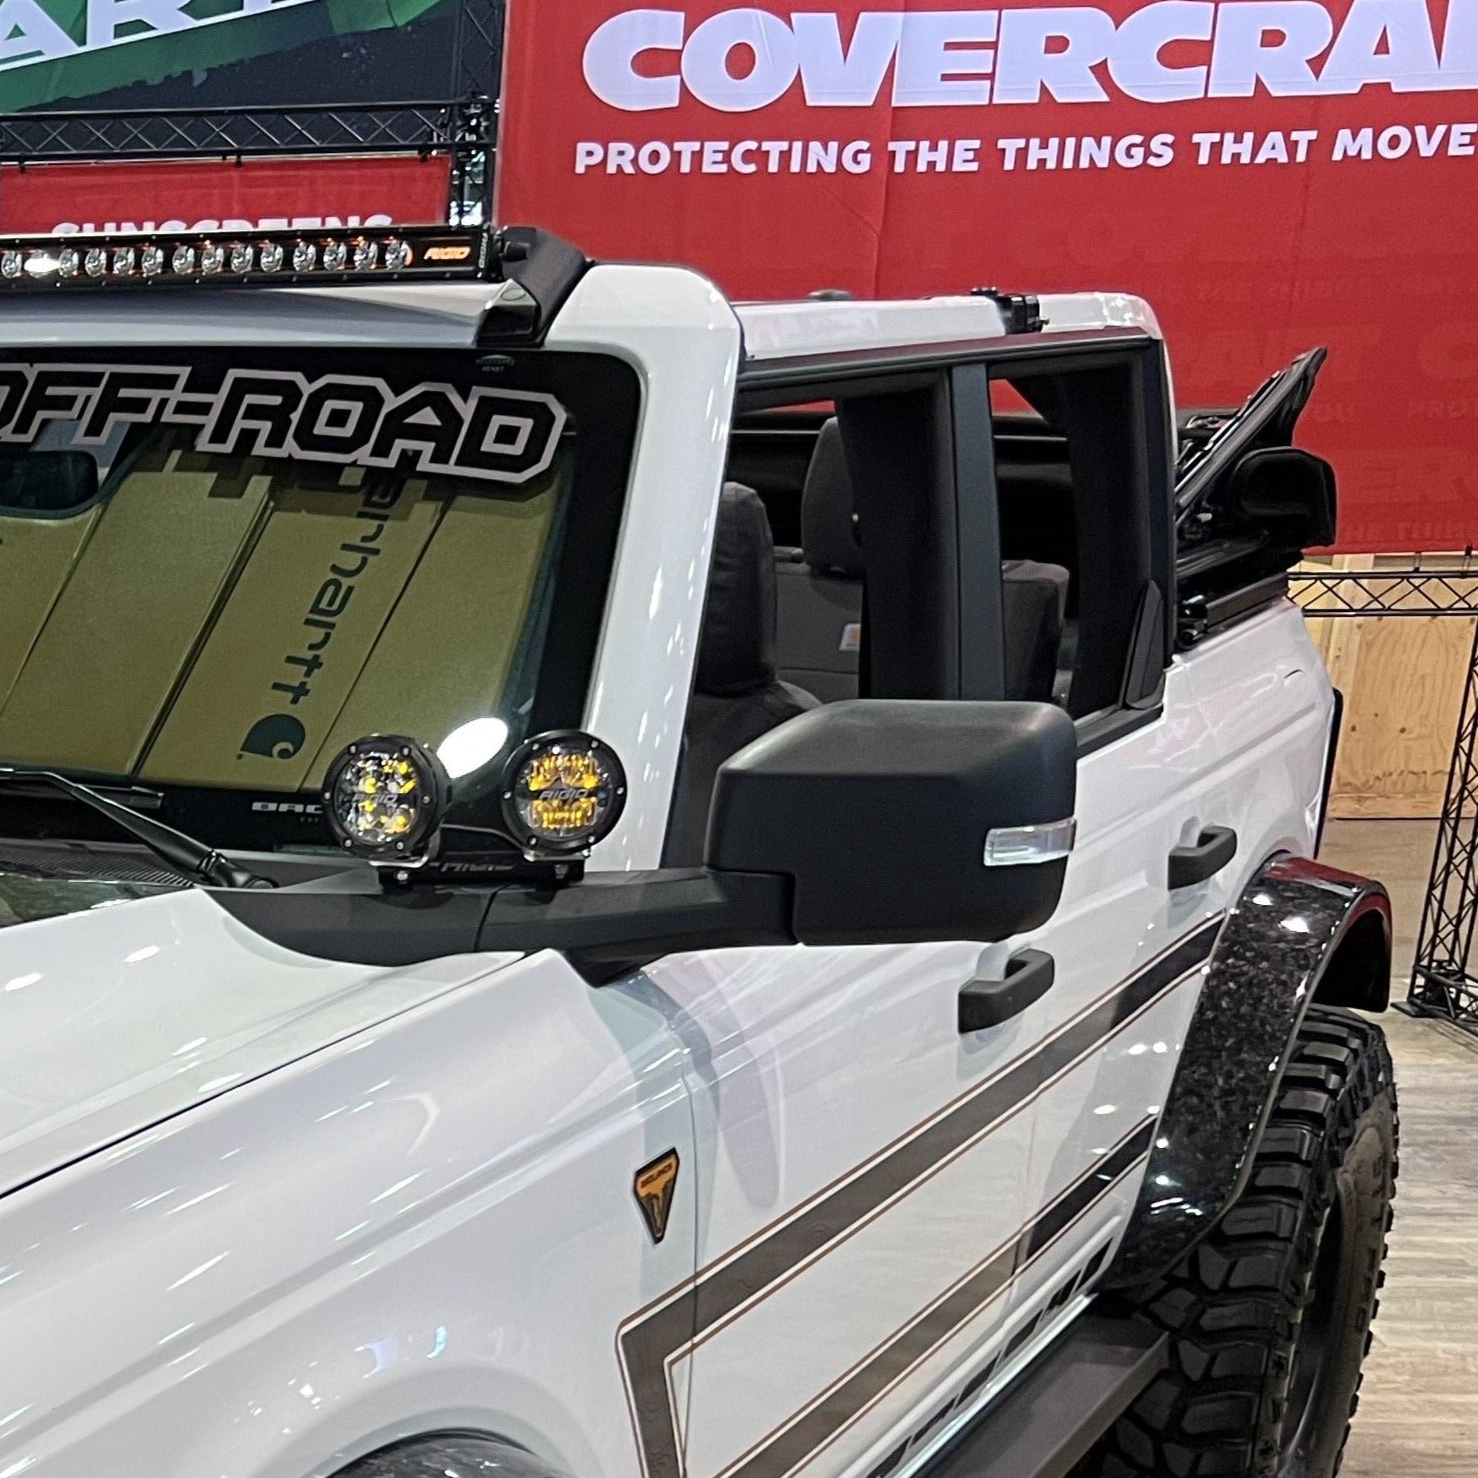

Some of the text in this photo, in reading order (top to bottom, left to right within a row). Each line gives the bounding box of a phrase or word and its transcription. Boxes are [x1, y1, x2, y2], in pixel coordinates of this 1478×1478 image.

[574, 123, 1478, 175] PROTECTING THE THINGS THAT MOVE
